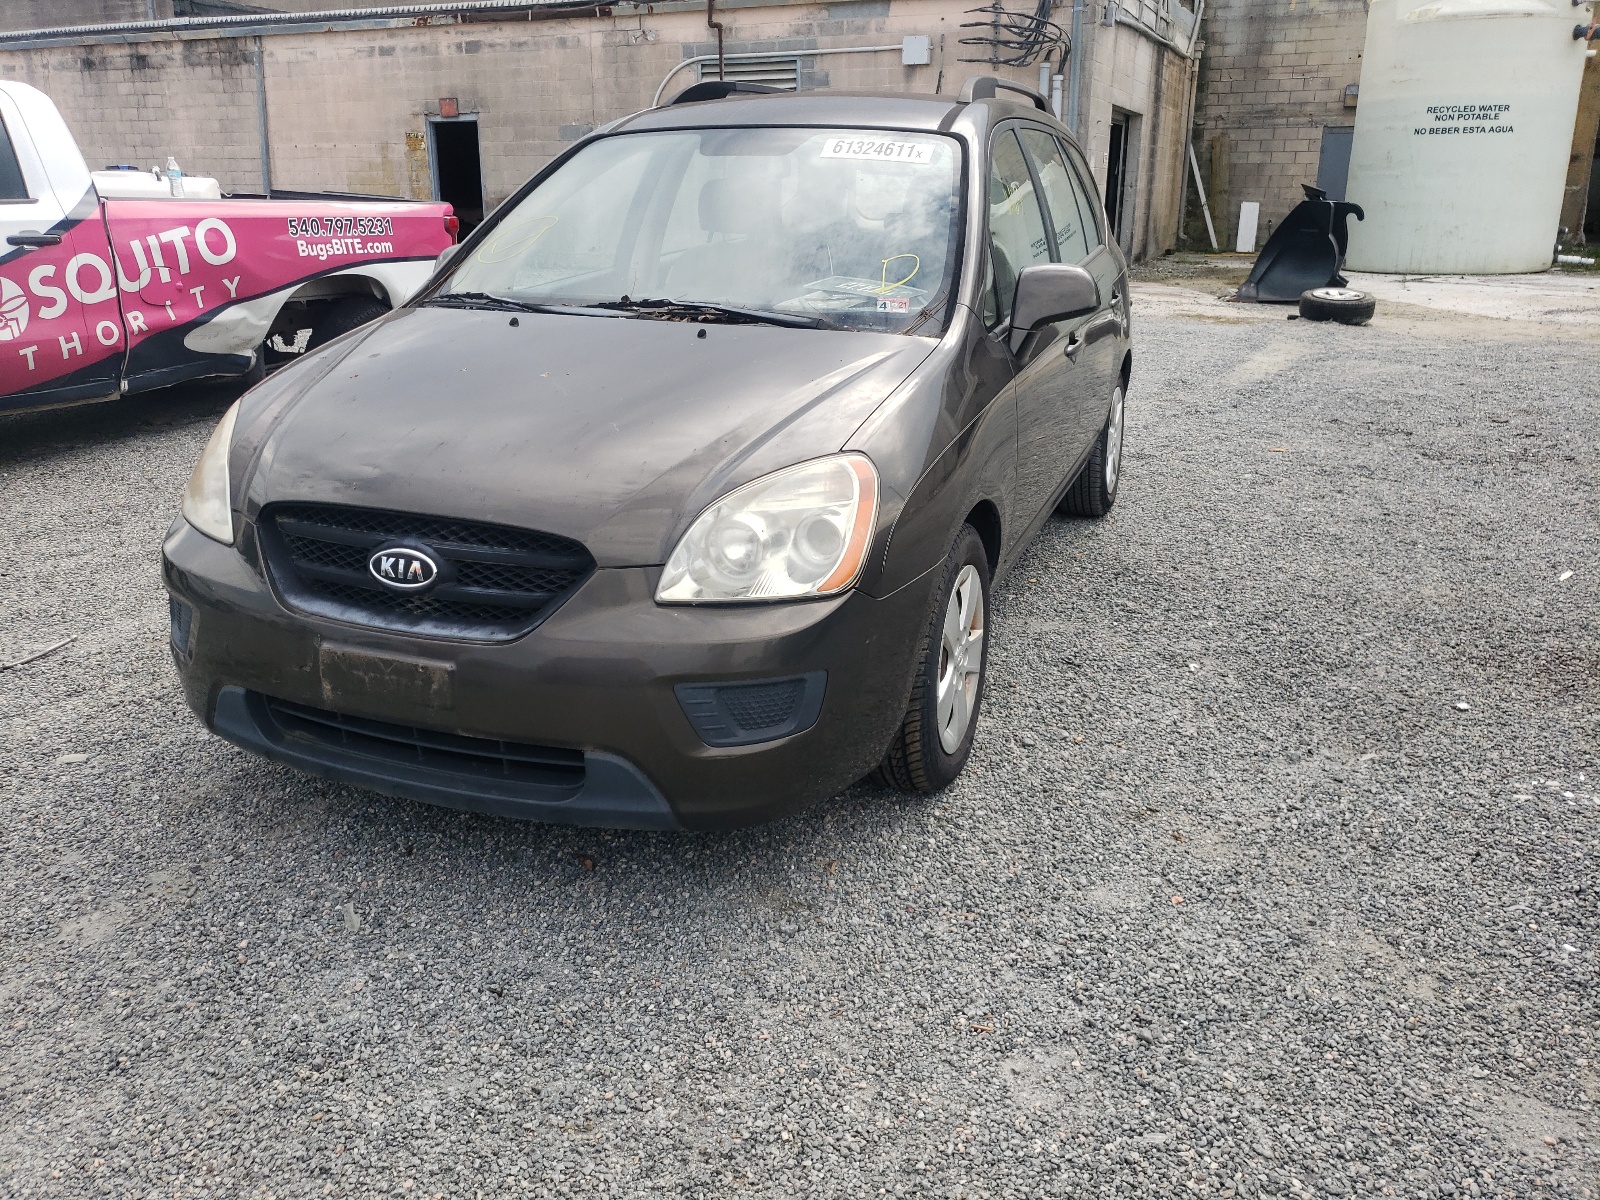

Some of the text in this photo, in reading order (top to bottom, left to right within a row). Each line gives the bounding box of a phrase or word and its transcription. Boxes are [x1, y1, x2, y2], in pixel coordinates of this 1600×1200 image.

[1426, 104, 1511, 114] RECYCLED WATER
[1434, 113, 1500, 122] NON POTABLE
[1413, 125, 1514, 136] NO BEBER ESTA AGUA
[287, 217, 394, 238] 540.797.5231
[296, 239, 394, 261] BugsBITE.com
[28, 218, 237, 320] SQUITO
[879, 301, 888, 310] 4
[18, 276, 241, 371] THORITY
[380, 556, 425, 582] KIA
